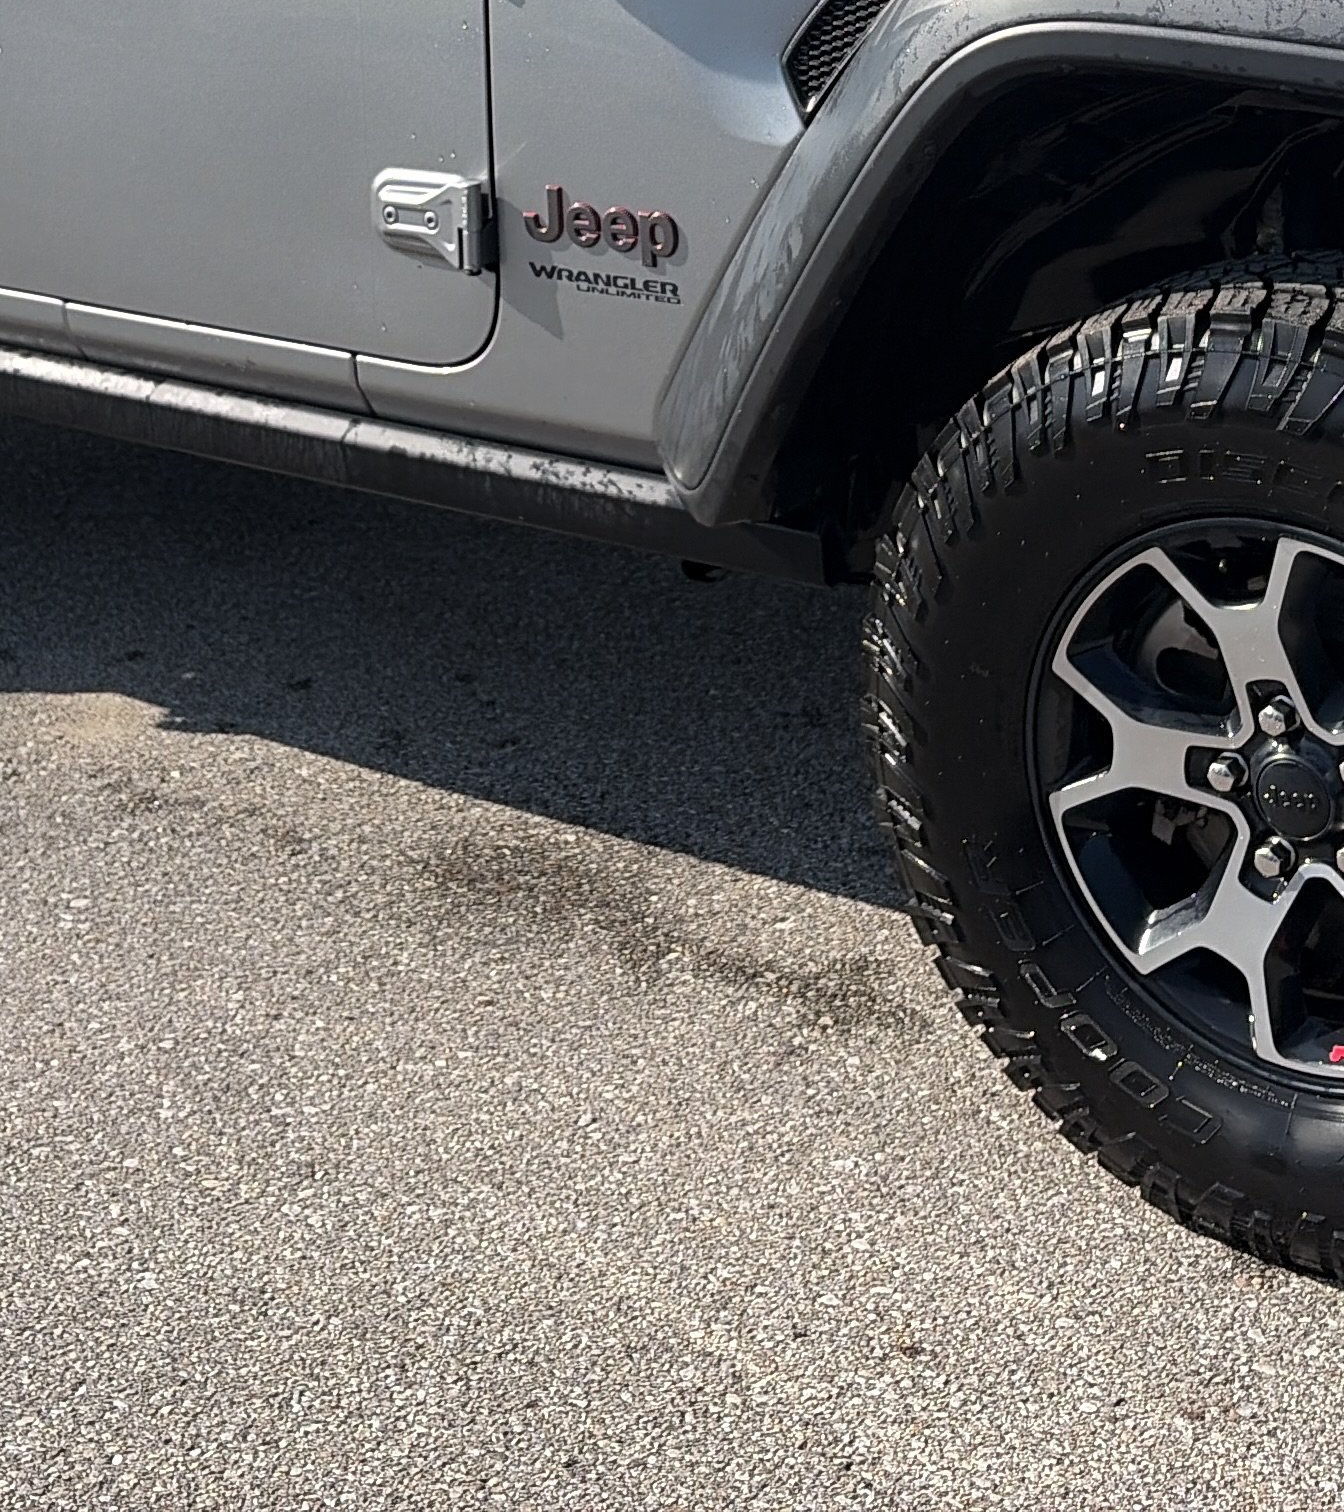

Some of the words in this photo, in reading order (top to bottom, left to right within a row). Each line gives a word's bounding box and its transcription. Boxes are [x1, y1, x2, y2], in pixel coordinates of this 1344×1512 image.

[522, 184, 680, 268] Jeep
[528, 261, 680, 298] WRANGLER
[575, 284, 682, 306] UNLIMITED
